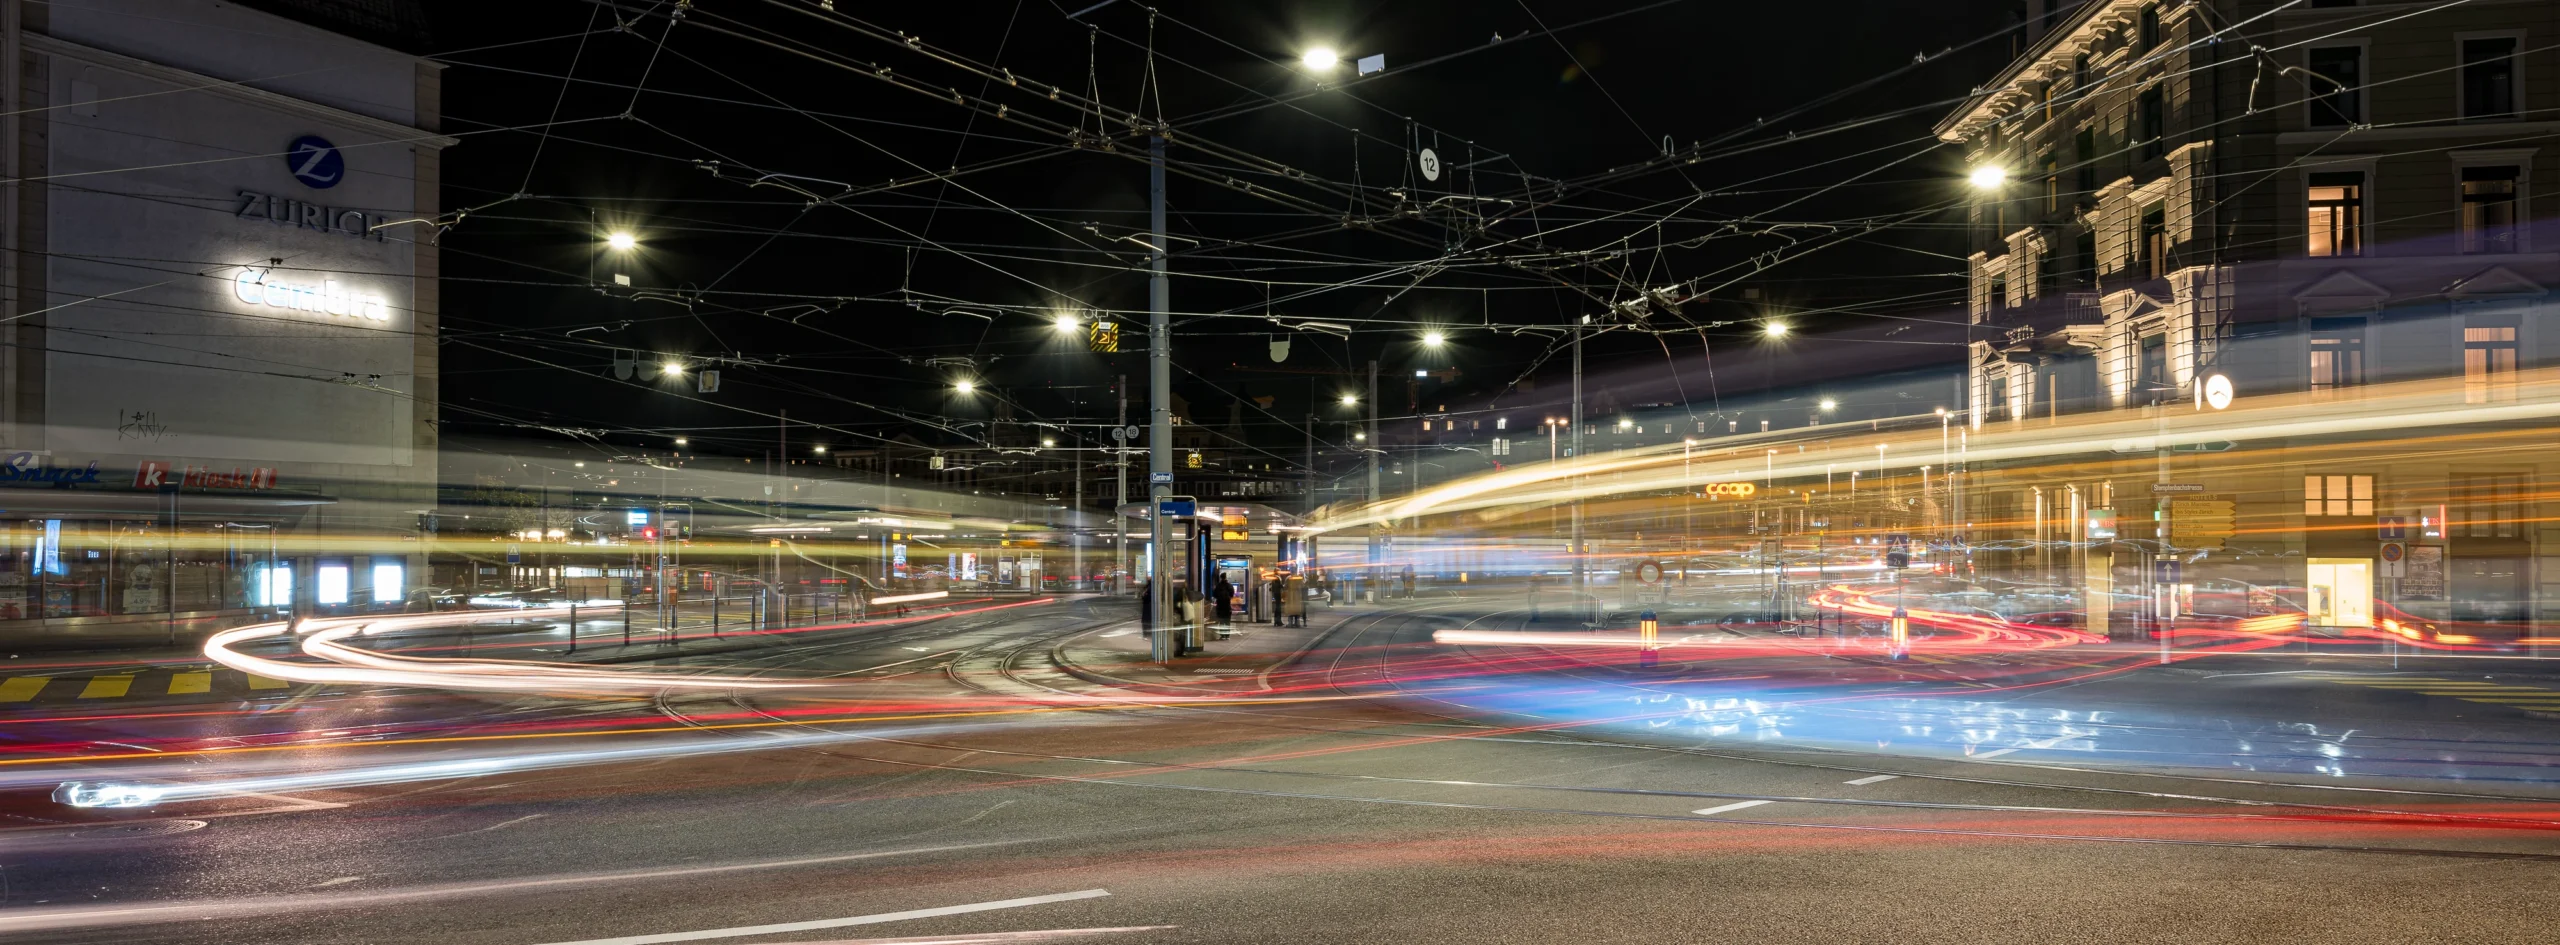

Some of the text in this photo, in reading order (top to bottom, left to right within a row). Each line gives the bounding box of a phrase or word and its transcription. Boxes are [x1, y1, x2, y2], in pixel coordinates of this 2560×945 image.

[295, 143, 336, 182] Z
[1424, 157, 1436, 172] 12
[237, 190, 390, 244] ZURICH
[235, 269, 389, 321] Cembra
[3, 452, 101, 483] Snack
[182, 464, 248, 488] kiosk
[1152, 473, 1171, 481] Central
[1705, 482, 1755, 498] coop
